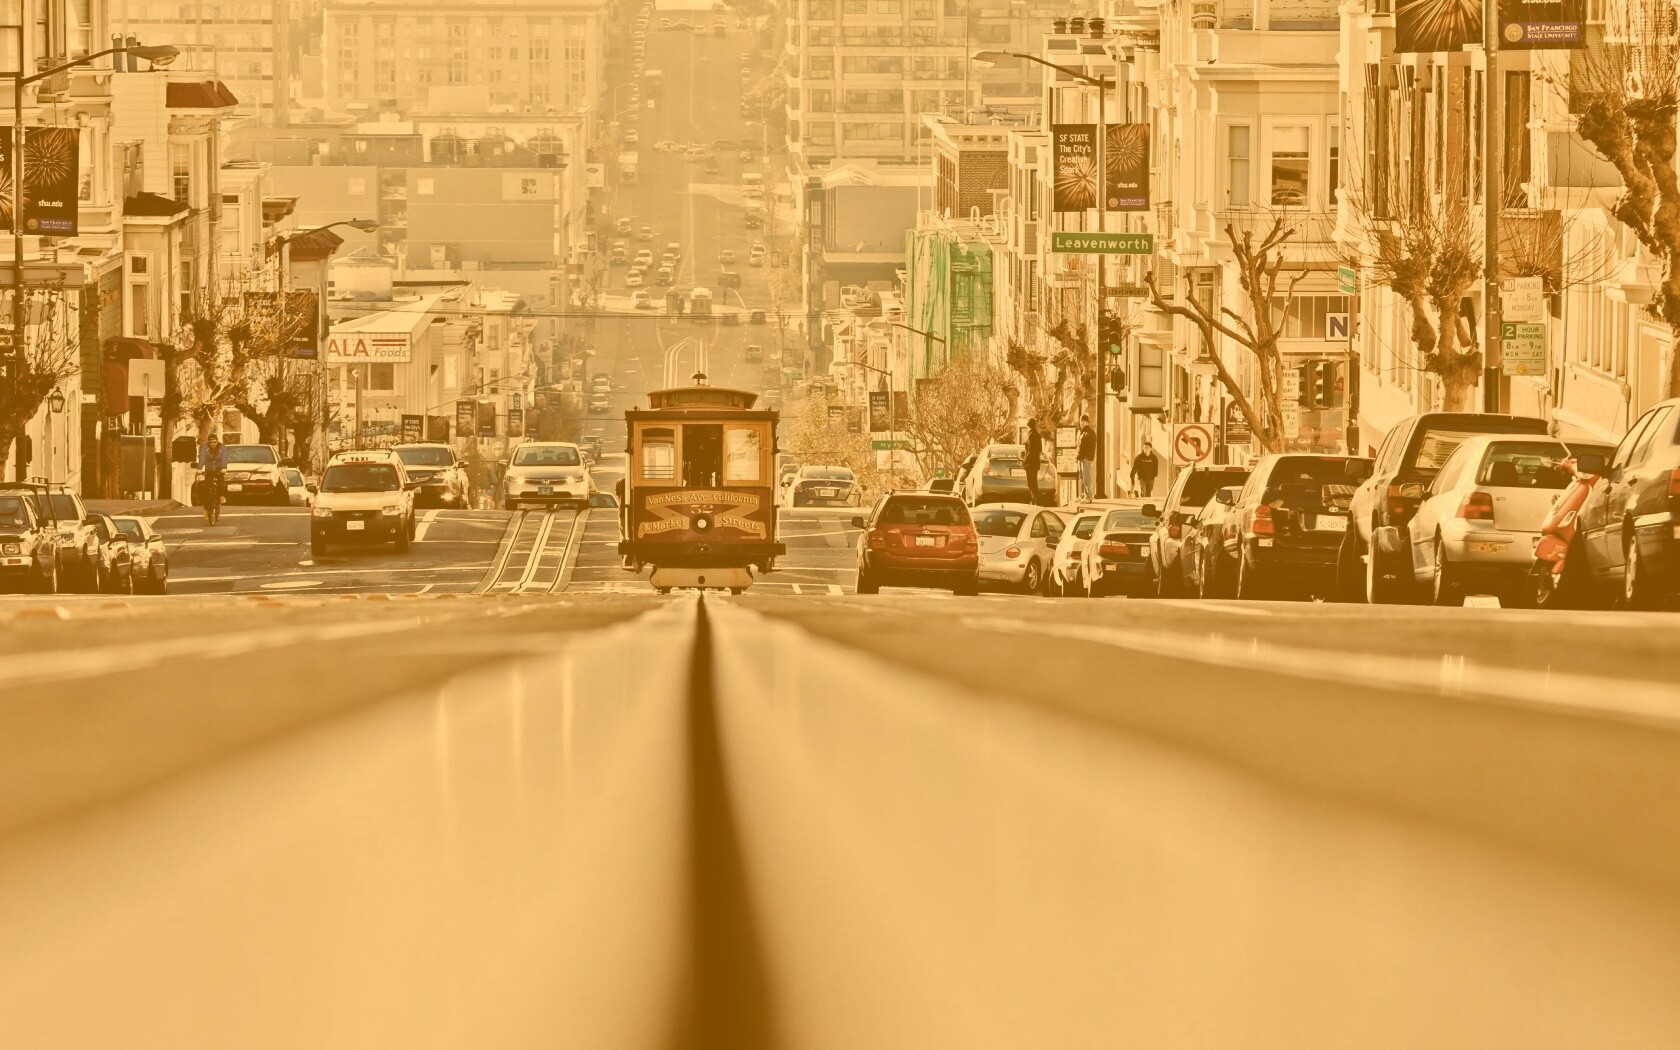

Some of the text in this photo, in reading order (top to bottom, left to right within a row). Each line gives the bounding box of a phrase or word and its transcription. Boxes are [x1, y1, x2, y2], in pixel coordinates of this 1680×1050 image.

[1059, 134, 1090, 143] SF STATE
[1059, 144, 1092, 154] The City's
[38, 200, 63, 208] sfsu.edu
[1056, 237, 1149, 250] Leavenworth
[1503, 280, 1541, 291] NO PARKING
[1511, 304, 1535, 312] MONDAY
[1505, 326, 1514, 337] 2
[374, 347, 407, 357] Foods
[648, 492, 760, 505] Van Ness Ave. California
[690, 504, 714, 514] 52
[651, 519, 686, 530] Market
[722, 516, 760, 530] Streets
